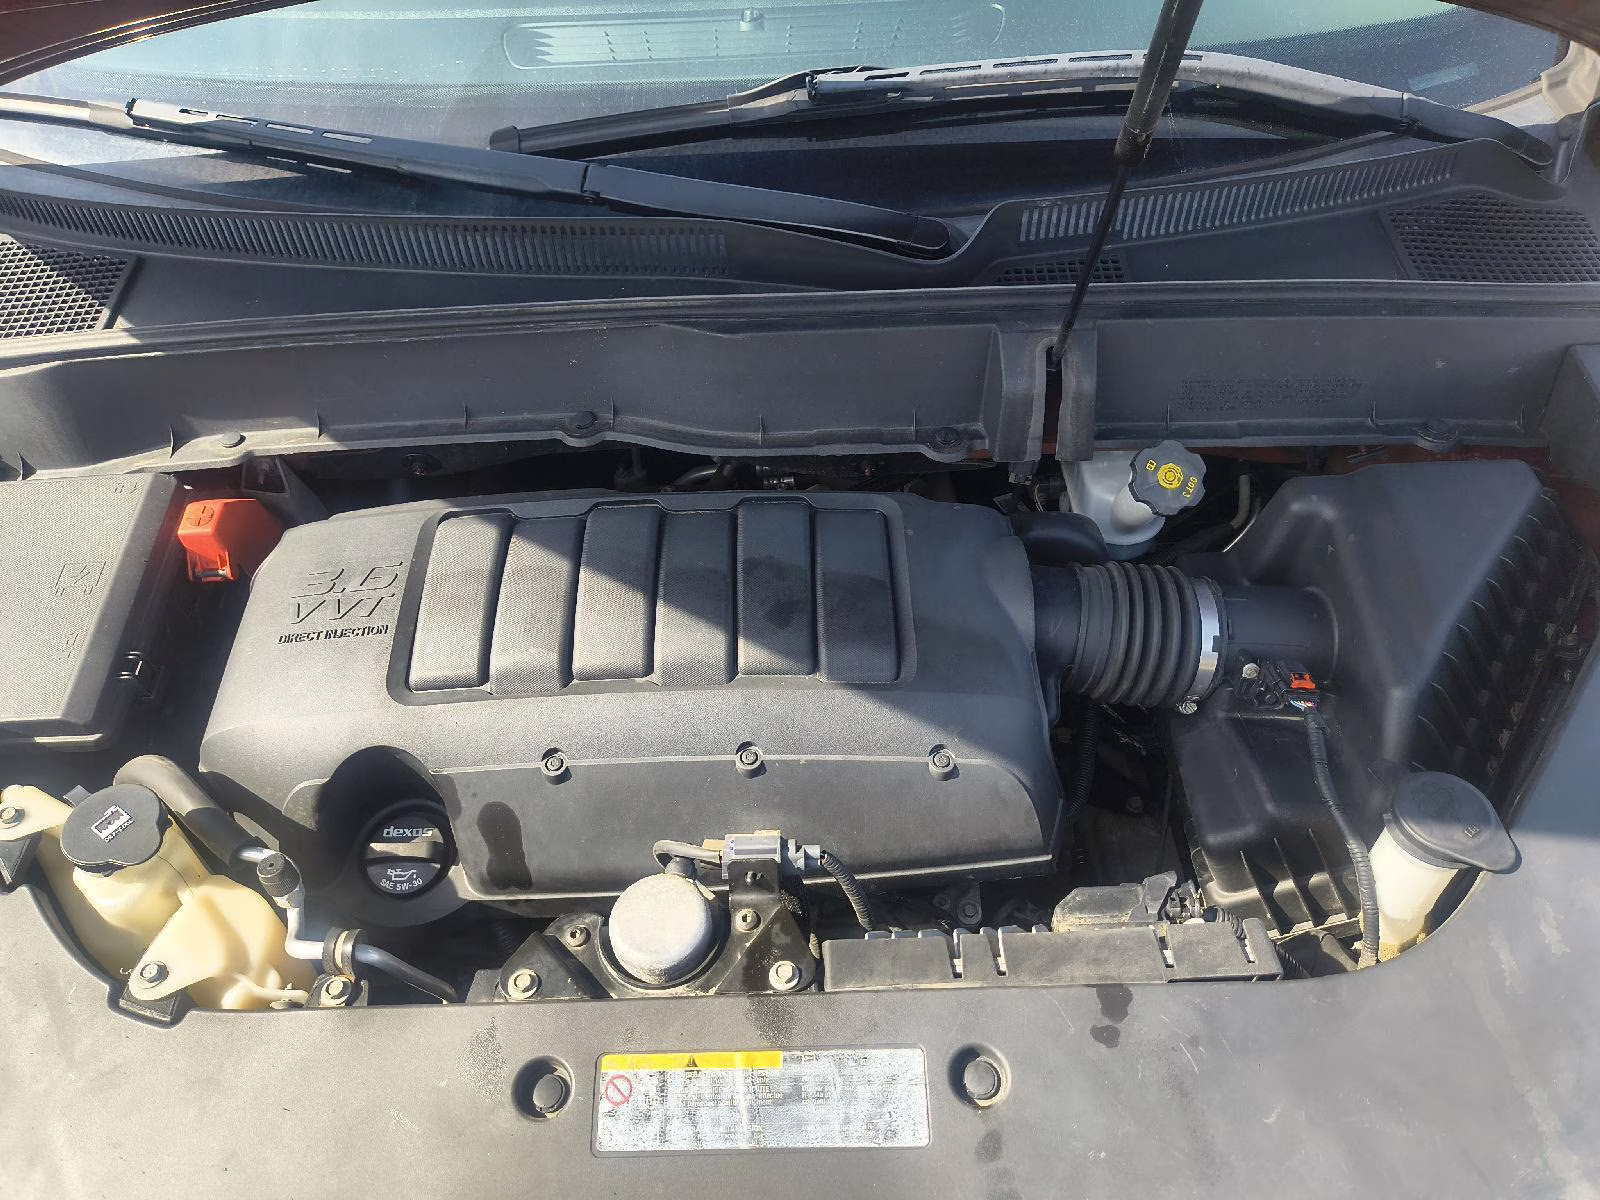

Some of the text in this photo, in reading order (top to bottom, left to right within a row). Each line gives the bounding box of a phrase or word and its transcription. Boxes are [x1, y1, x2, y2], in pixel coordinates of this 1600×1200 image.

[289, 561, 403, 599] 3.6
[290, 593, 396, 625] VVT
[277, 624, 389, 645] DIRECT INJECTION
[382, 825, 435, 838] dexos
[380, 878, 423, 891] SAE 5W-30
